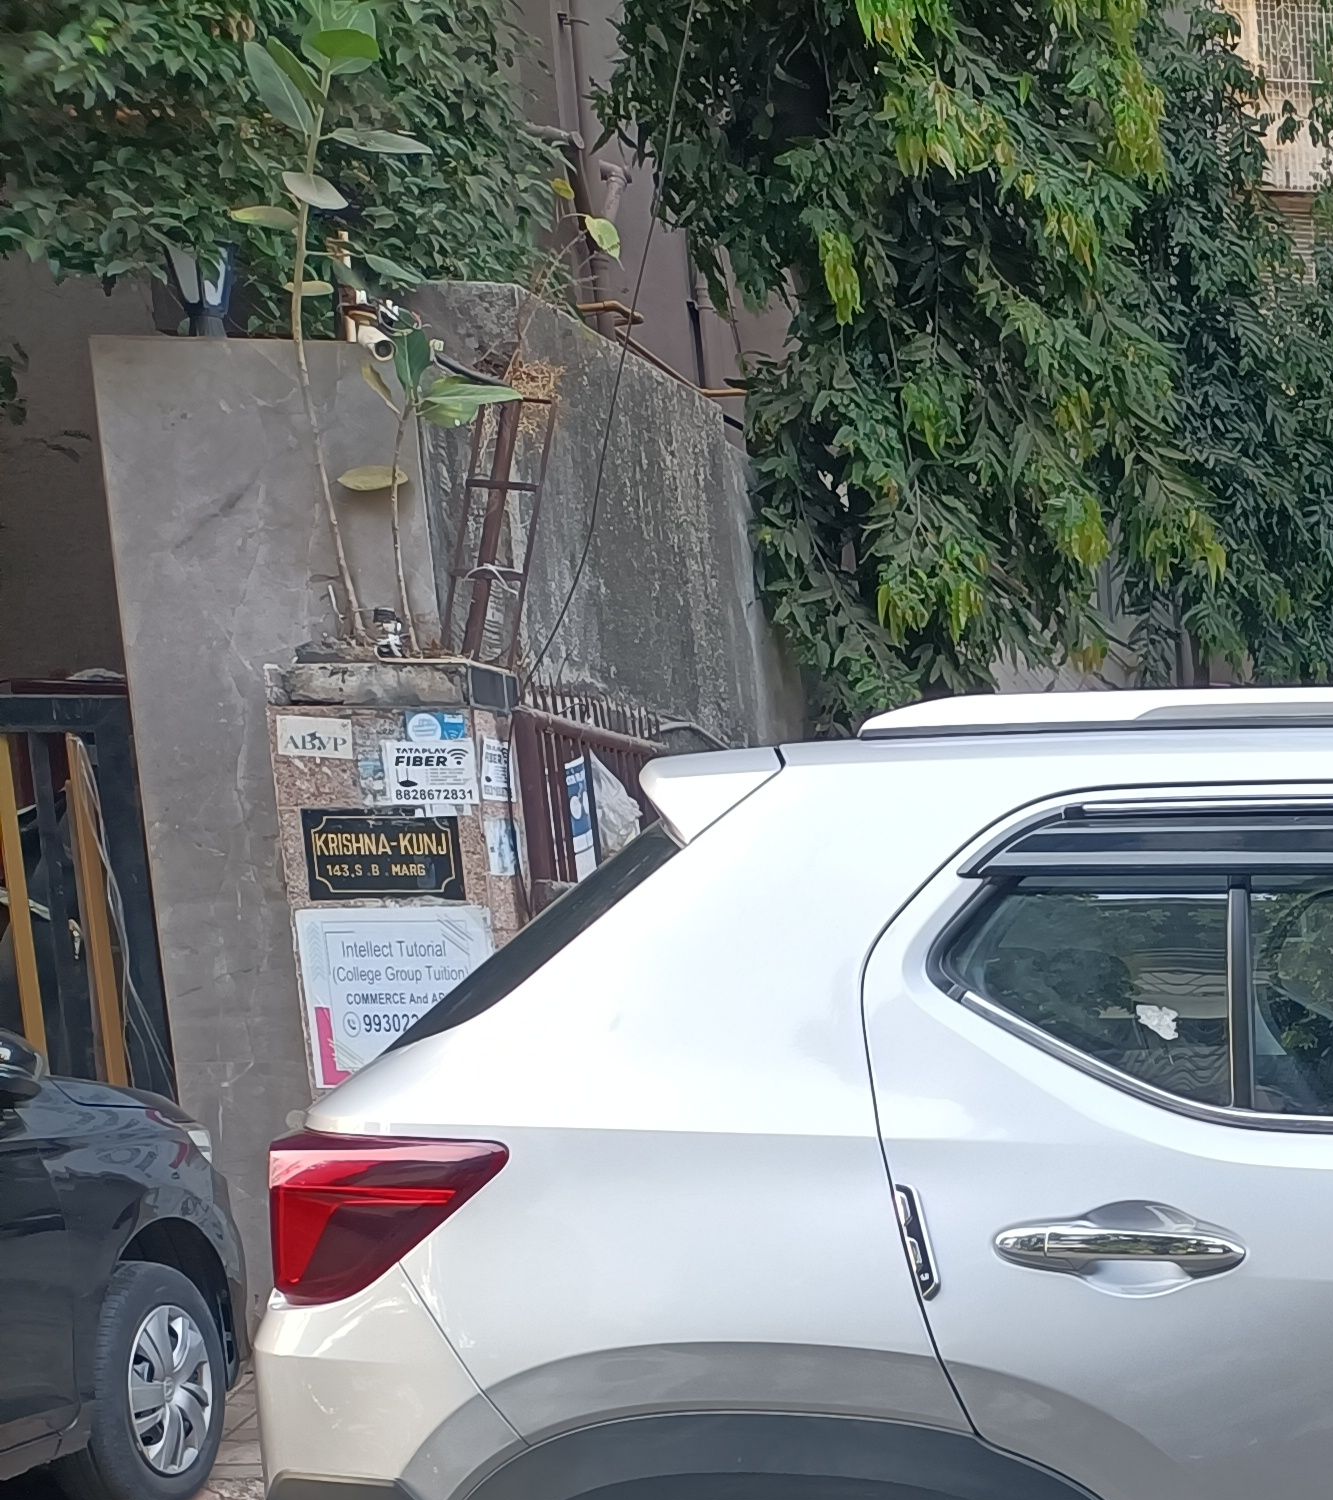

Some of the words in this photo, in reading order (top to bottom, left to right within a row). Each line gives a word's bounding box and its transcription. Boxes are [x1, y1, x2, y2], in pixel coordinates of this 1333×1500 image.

[395, 755, 448, 767] FIBER
[395, 789, 474, 800] 8828672831
[315, 832, 447, 857] KRISHNA-KUNJ
[391, 864, 426, 877] MARG
[341, 941, 393, 958] Intellect
[397, 940, 447, 957] Tutorial
[333, 966, 382, 984] (College
[385, 967, 422, 983] Group
[425, 966, 469, 981] Tuition)
[346, 993, 406, 1005] COMMERCE
[409, 993, 428, 1005] And
